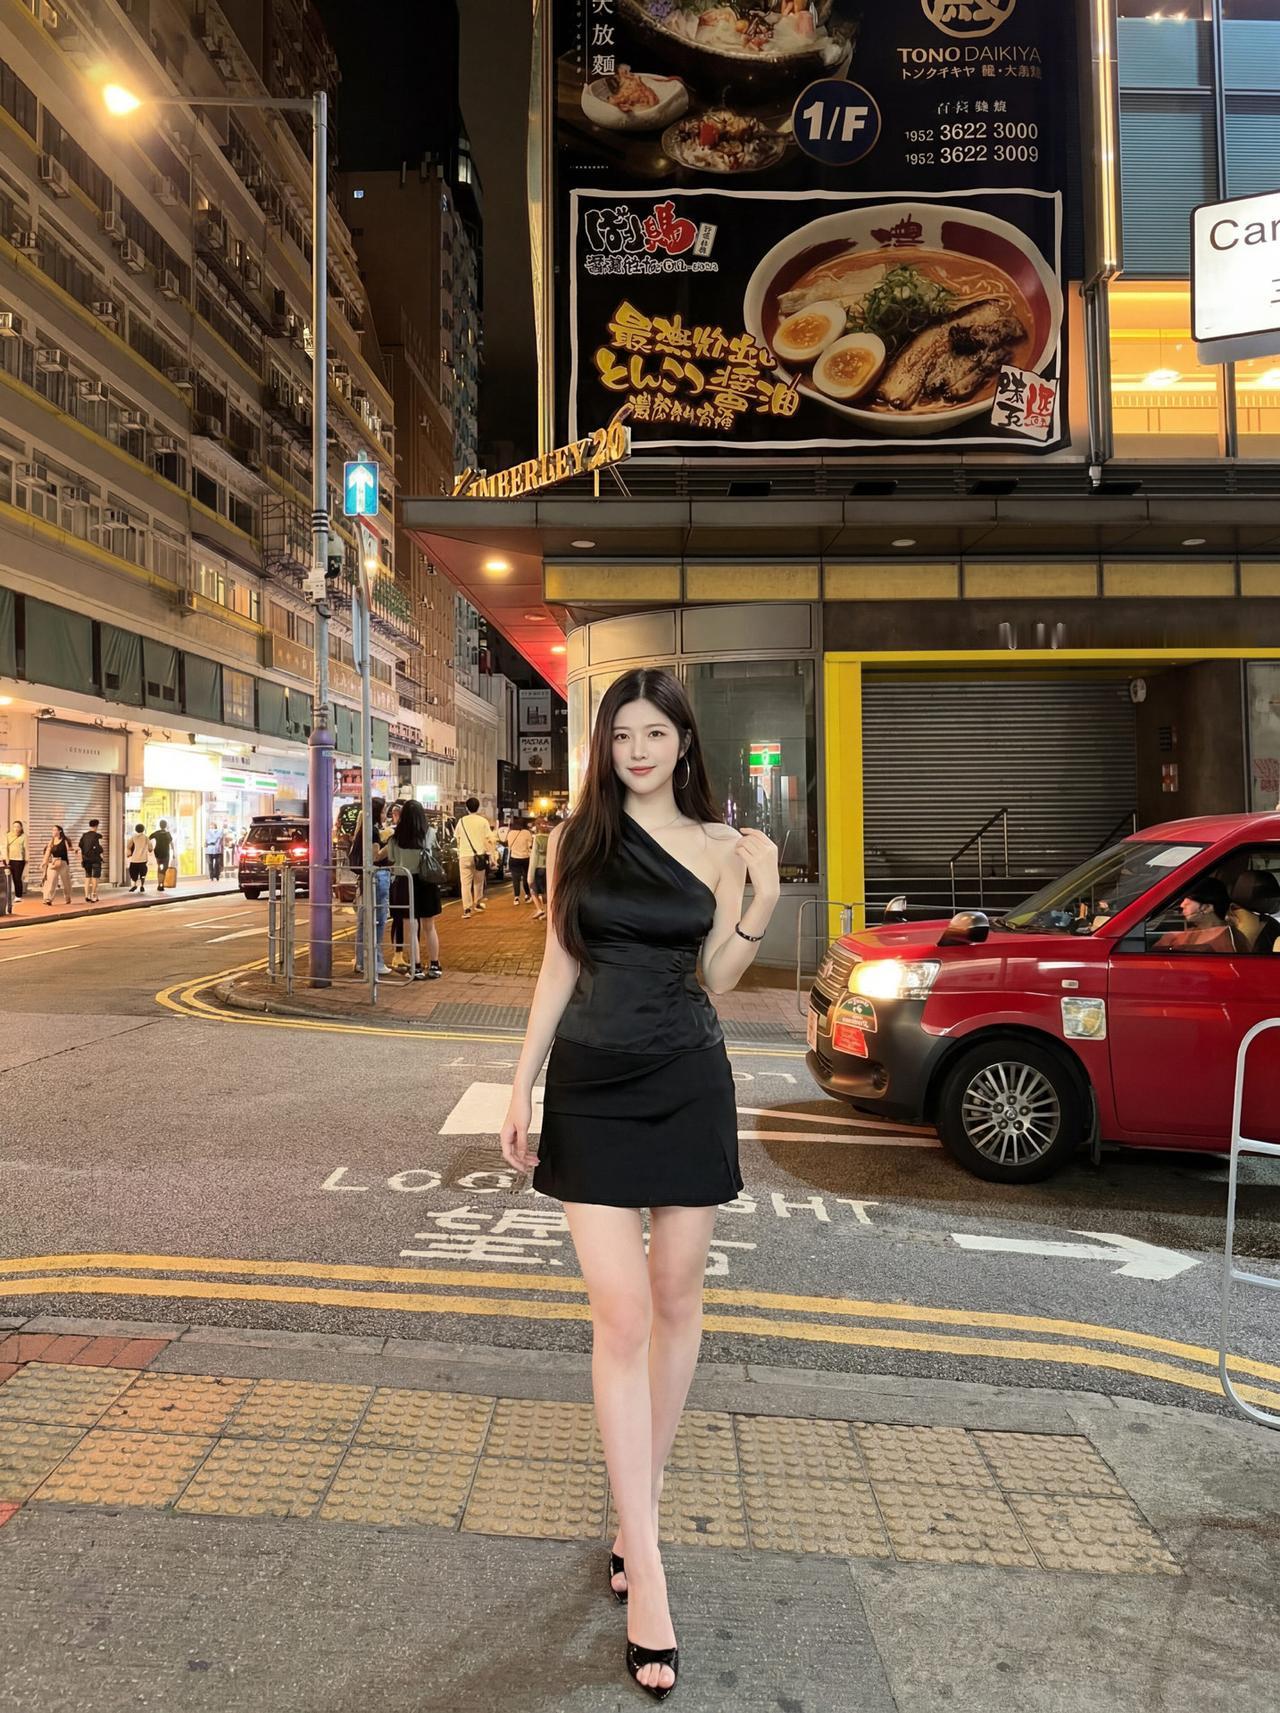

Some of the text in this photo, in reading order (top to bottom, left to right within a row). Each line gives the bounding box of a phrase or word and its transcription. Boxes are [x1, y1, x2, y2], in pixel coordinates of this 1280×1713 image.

[897, 46, 1041, 63] TONO DAIKIYA
[801, 101, 868, 142] 1/F
[940, 122, 987, 141] 3622
[993, 122, 1038, 140] 3000
[940, 145, 988, 164] 3622
[993, 145, 1039, 163] 3009
